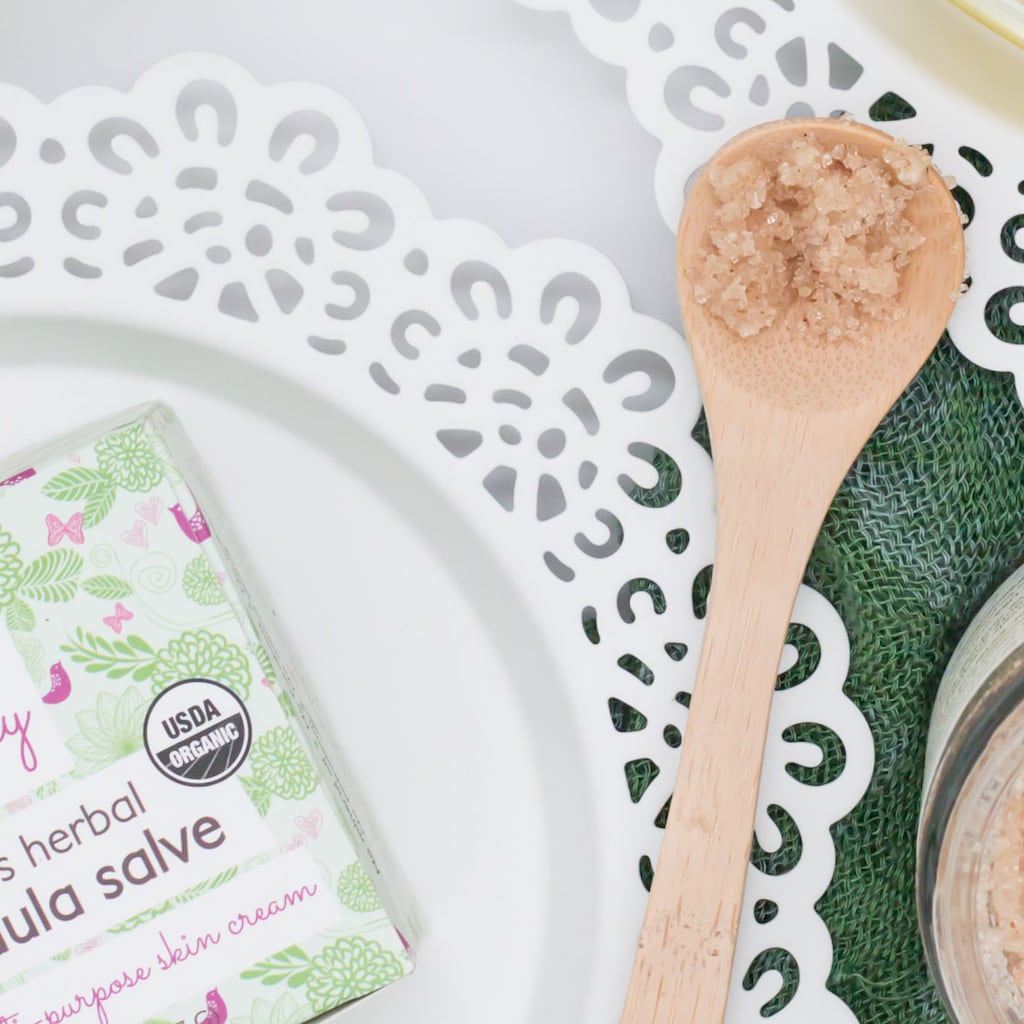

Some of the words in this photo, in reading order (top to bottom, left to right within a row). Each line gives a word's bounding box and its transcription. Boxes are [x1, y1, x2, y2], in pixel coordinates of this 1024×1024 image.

[161, 698, 222, 740] USDA
[168, 722, 240, 769] ORGANIC
[19, 780, 146, 868] herbal
[0, 887, 85, 955] ula
[96, 816, 226, 900] salve
[156, 931, 221, 971] skin
[228, 884, 317, 935] cream
